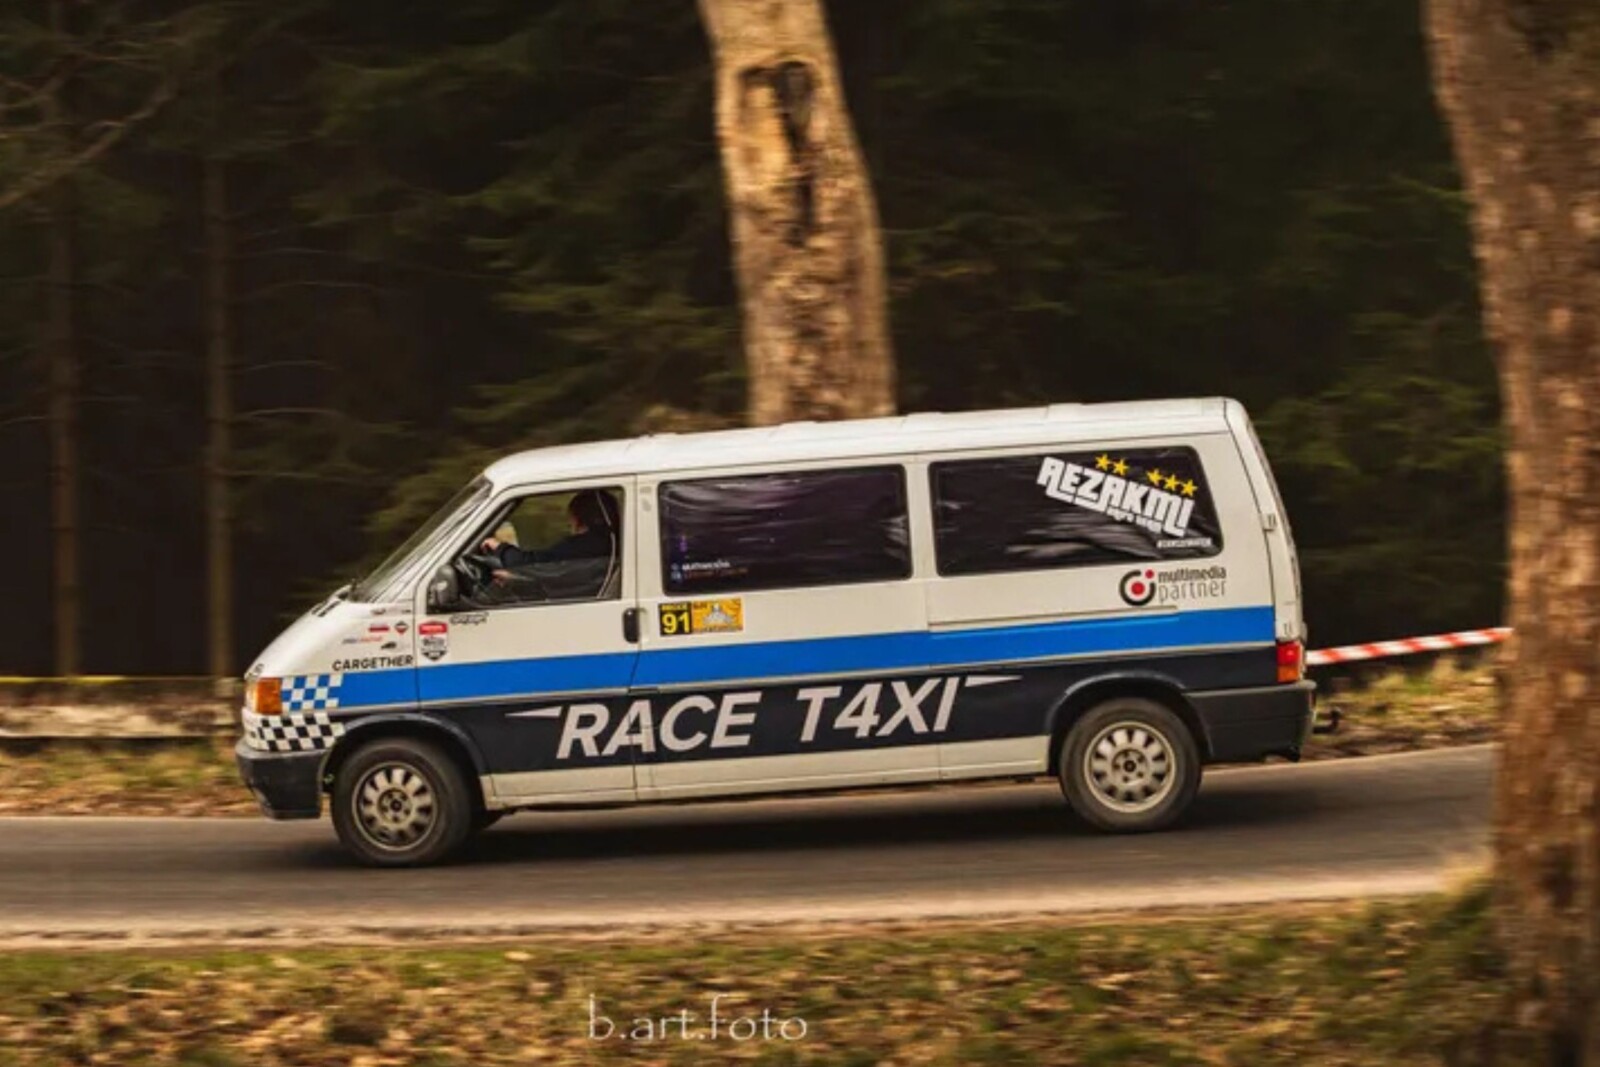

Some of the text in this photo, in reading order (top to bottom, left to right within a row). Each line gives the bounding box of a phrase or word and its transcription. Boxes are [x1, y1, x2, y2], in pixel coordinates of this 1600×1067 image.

[1158, 565, 1227, 583] multimedia
[1158, 580, 1227, 604] partner
[661, 611, 690, 634] 91
[332, 654, 414, 671] CARGETHER
[556, 677, 960, 760] RACE T4XI
